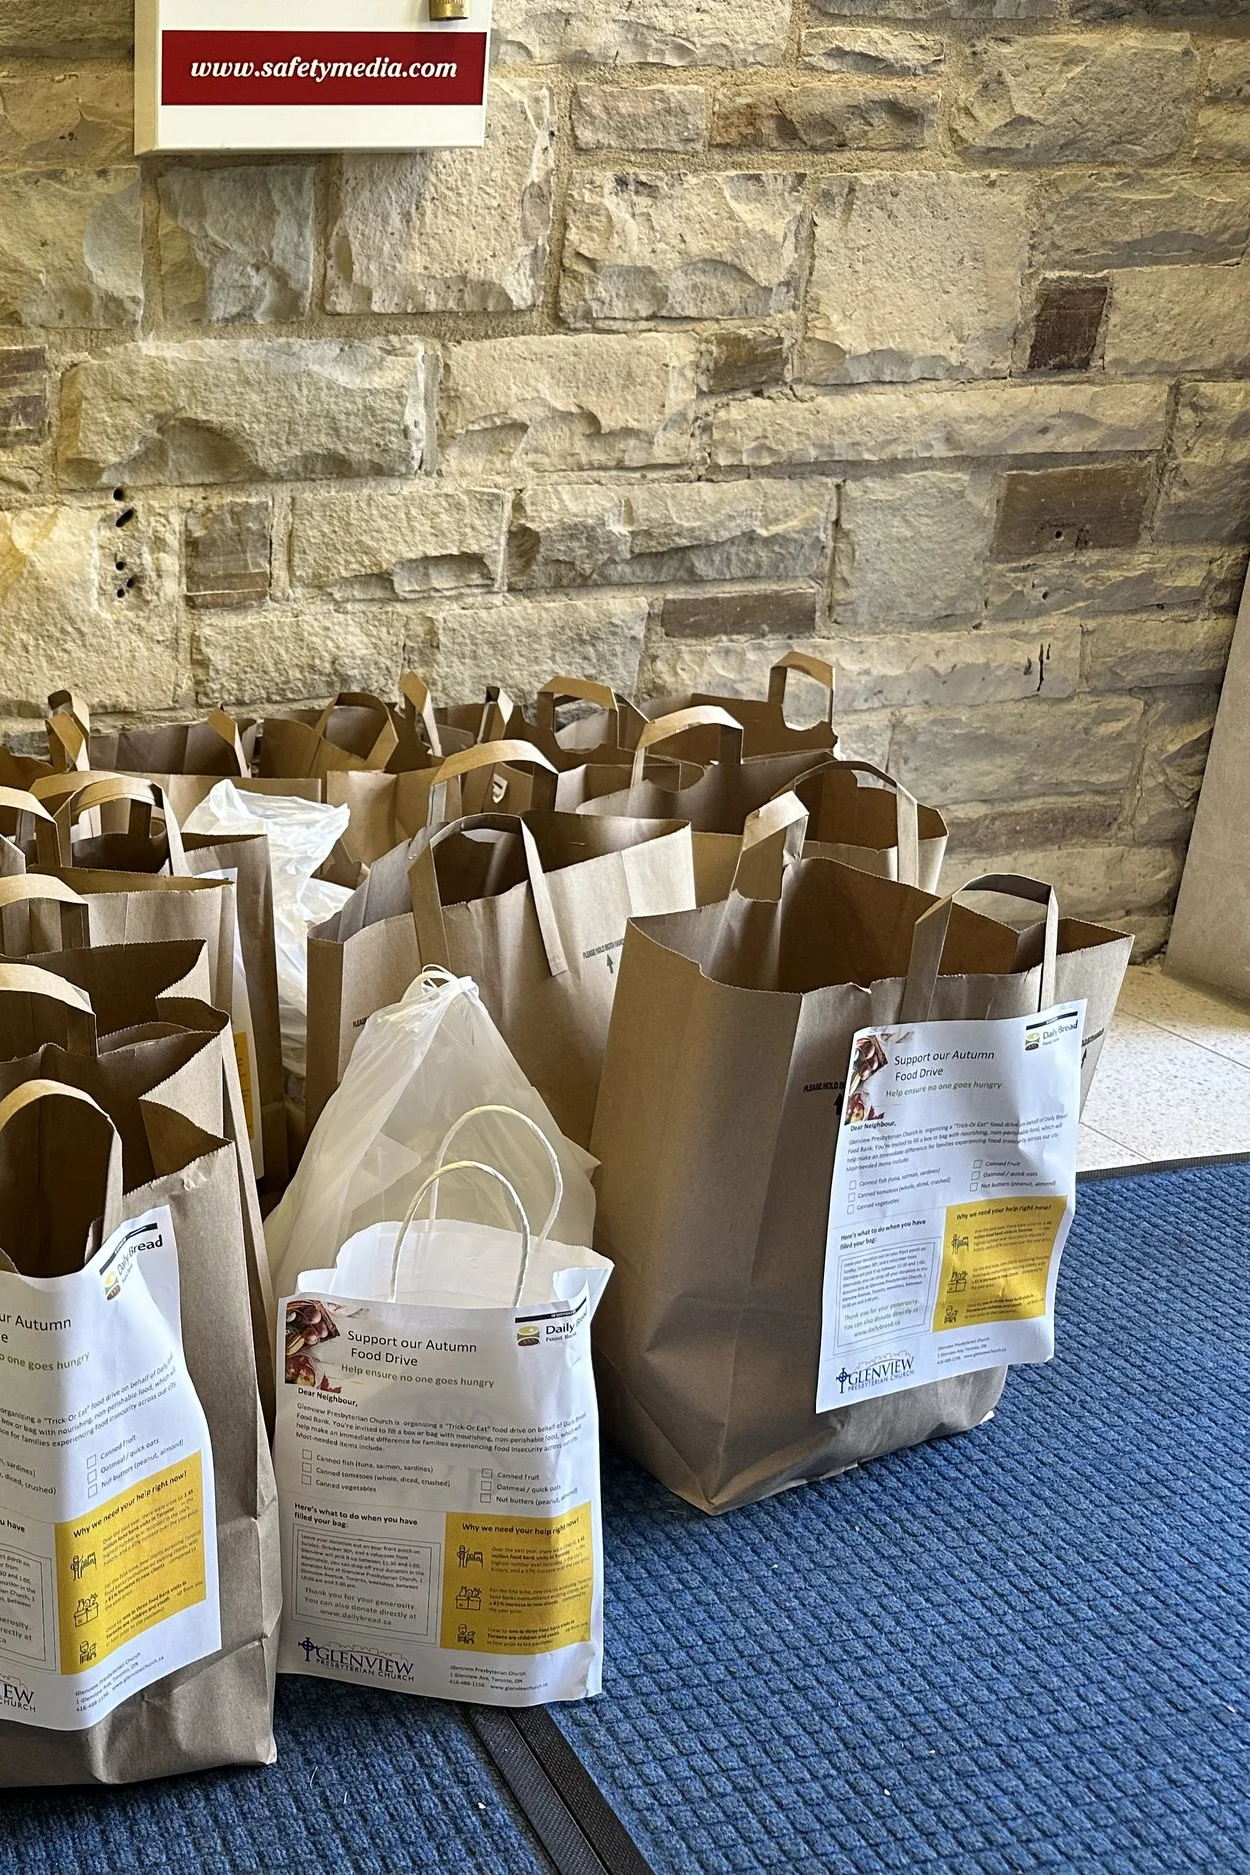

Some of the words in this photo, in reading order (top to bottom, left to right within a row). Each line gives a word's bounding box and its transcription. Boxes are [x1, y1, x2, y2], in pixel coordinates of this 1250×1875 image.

[190, 56, 457, 83] www.safetymedia.com
[1057, 1019, 1078, 1034] Bread
[894, 1052, 931, 1066] Support
[932, 1051, 950, 1062] our
[952, 1049, 995, 1061] Autumn
[895, 1069, 918, 1082] Food
[919, 1066, 943, 1079] Drive
[803, 1083, 823, 1092] PLEASE
[129, 1234, 164, 1258] Bread
[15, 1314, 72, 1331] Autumn
[545, 1323, 575, 1337] Daily
[347, 1329, 398, 1348] Support
[401, 1338, 423, 1349] our
[425, 1341, 477, 1353] Autumn
[350, 1347, 383, 1363] Food
[385, 1351, 418, 1367] Drive
[341, 1363, 363, 1377] Help
[365, 1369, 398, 1381] ensure
[400, 1375, 412, 1383] no
[414, 1376, 433, 1384] one
[435, 1377, 458, 1387] goes
[460, 1377, 495, 1389] hungry
[848, 1356, 915, 1385] GLENVIEW
[848, 1375, 889, 1392] PRESBYTERIAN
[890, 1369, 915, 1380] CHURCH
[315, 1648, 414, 1675] GLENVIEW
[315, 1657, 376, 1676] PRESBYTERIAN
[378, 1670, 414, 1682] CHURCH
